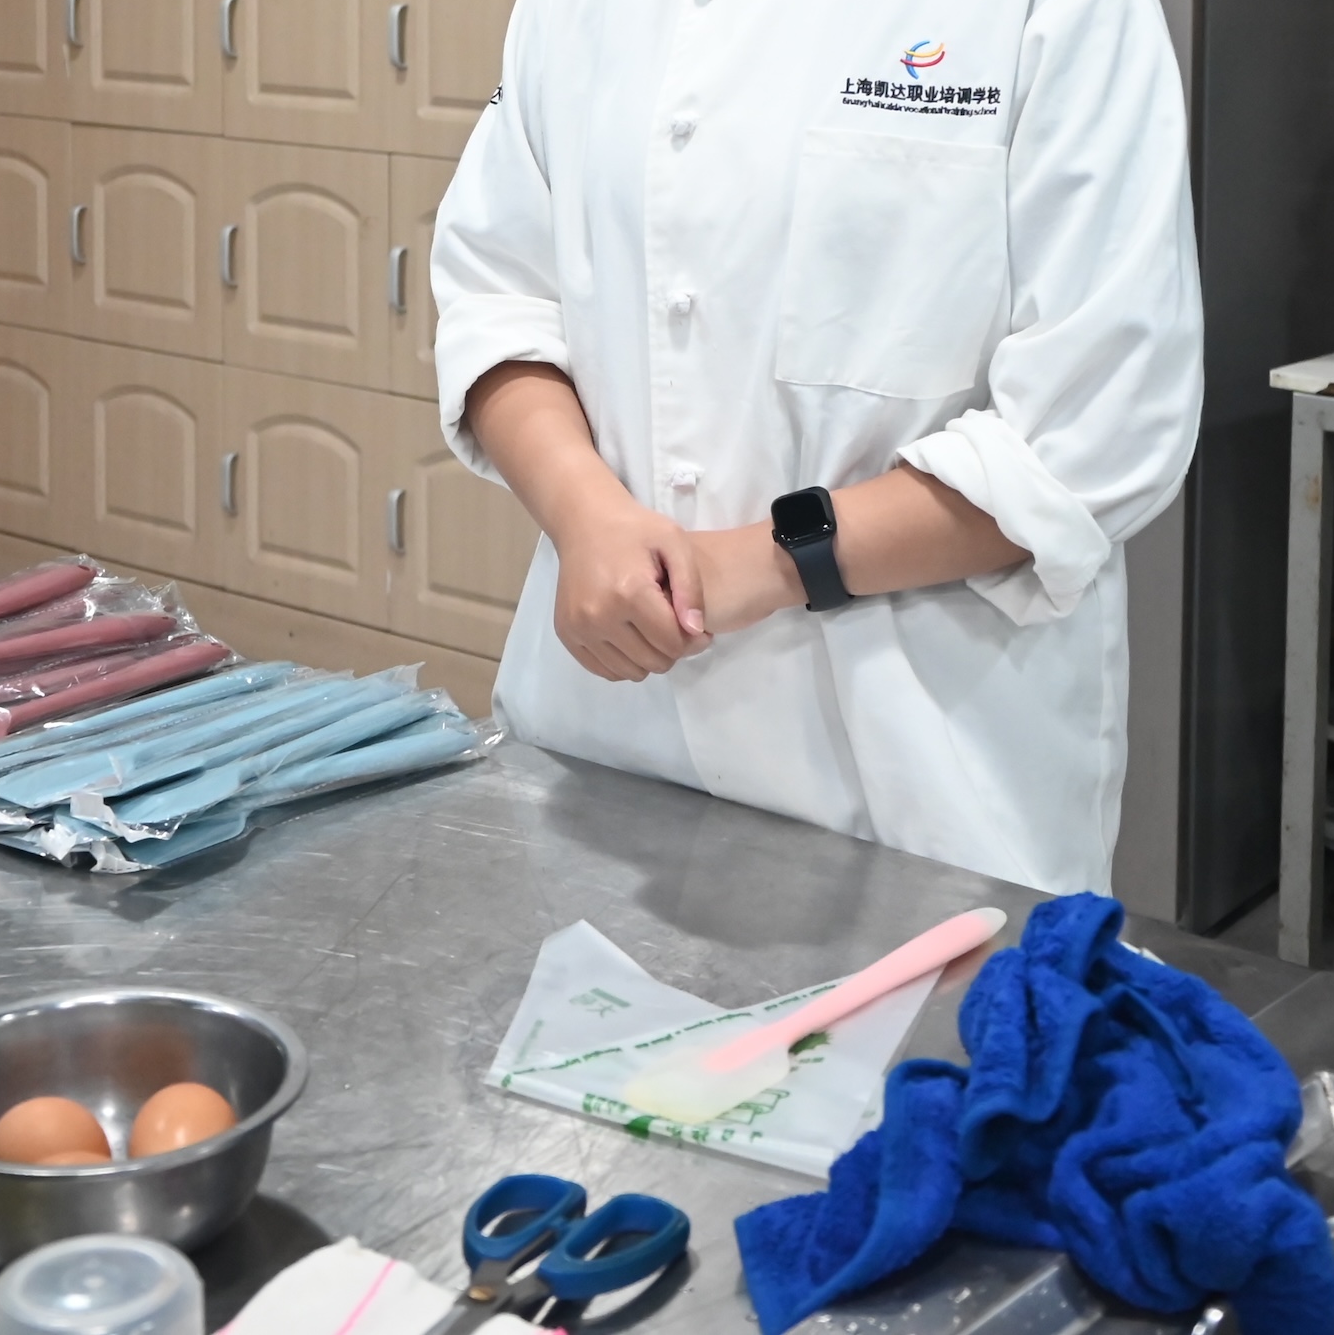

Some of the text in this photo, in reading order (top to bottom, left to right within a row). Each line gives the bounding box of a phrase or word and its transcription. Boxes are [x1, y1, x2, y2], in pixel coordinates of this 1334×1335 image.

[840, 77, 1001, 105] 上海凯达职业培训学校
